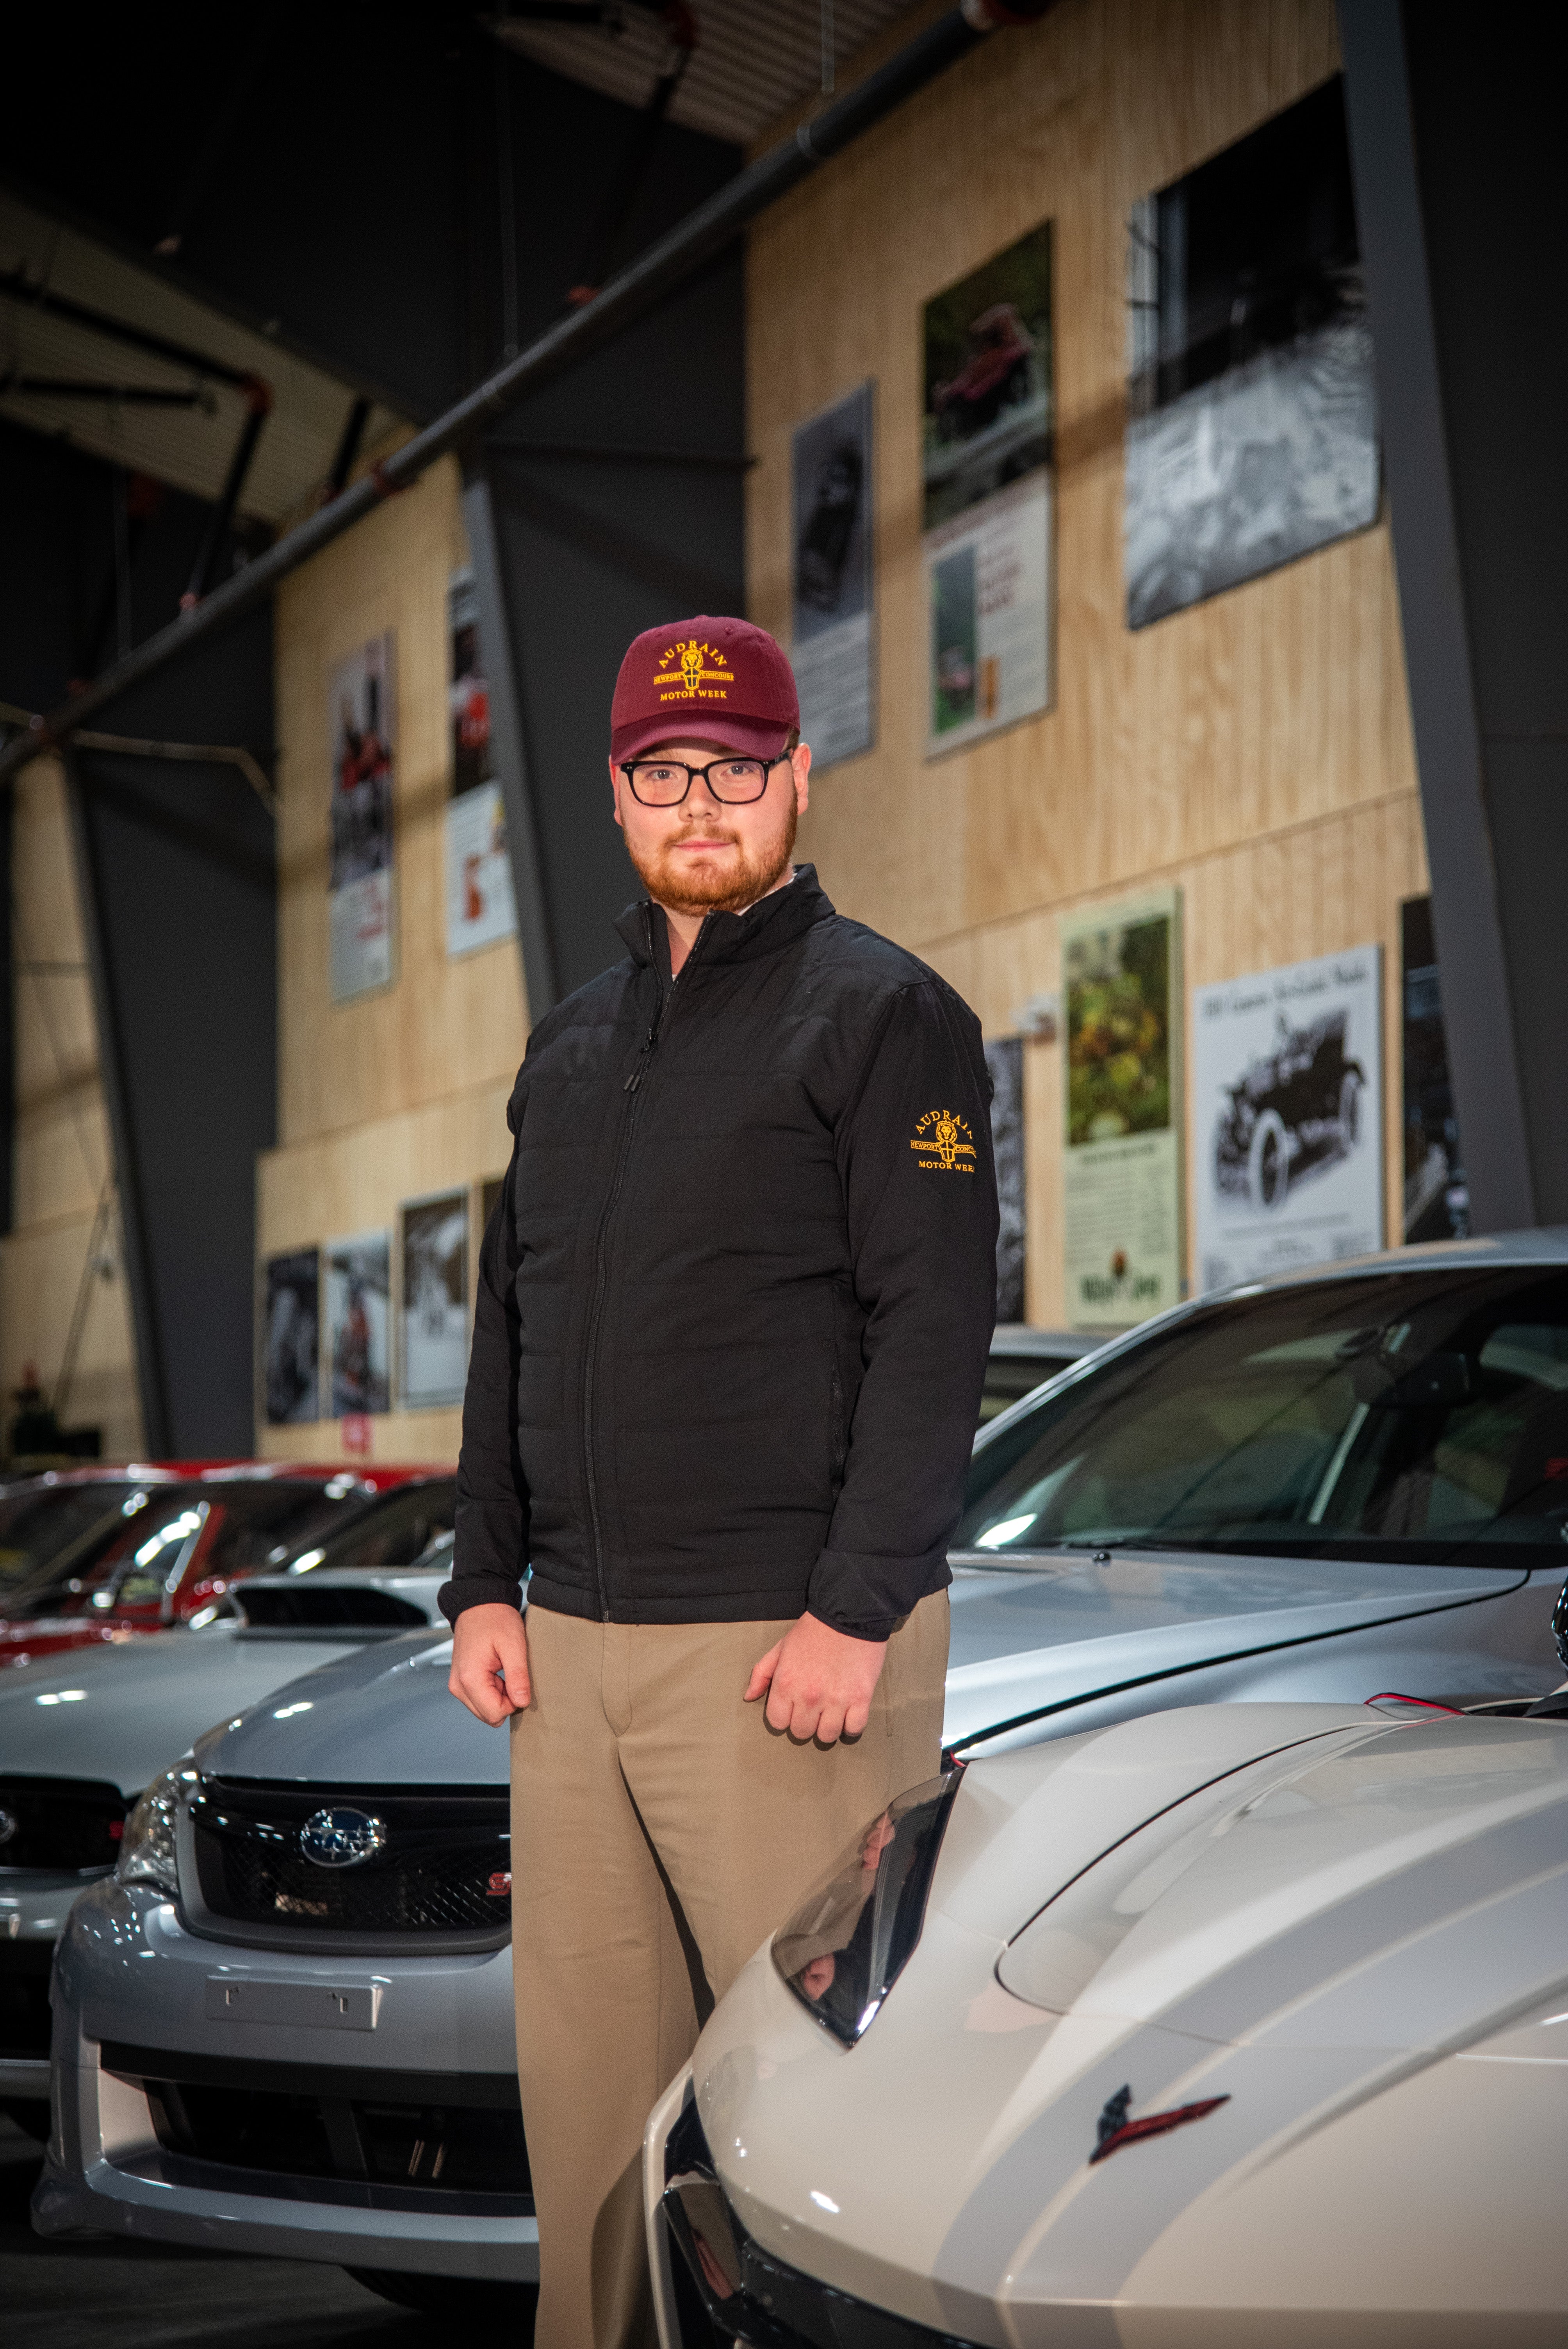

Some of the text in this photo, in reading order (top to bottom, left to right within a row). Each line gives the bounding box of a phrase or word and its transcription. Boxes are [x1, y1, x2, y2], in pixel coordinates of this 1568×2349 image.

[659, 640, 727, 668] AUDRAIN
[654, 674, 682, 683] NEWPORT
[660, 690, 727, 701] MOTOR WEEK
[911, 1141, 938, 1150] NEWPORT
[919, 1160, 975, 1173] MOTOR WEE
